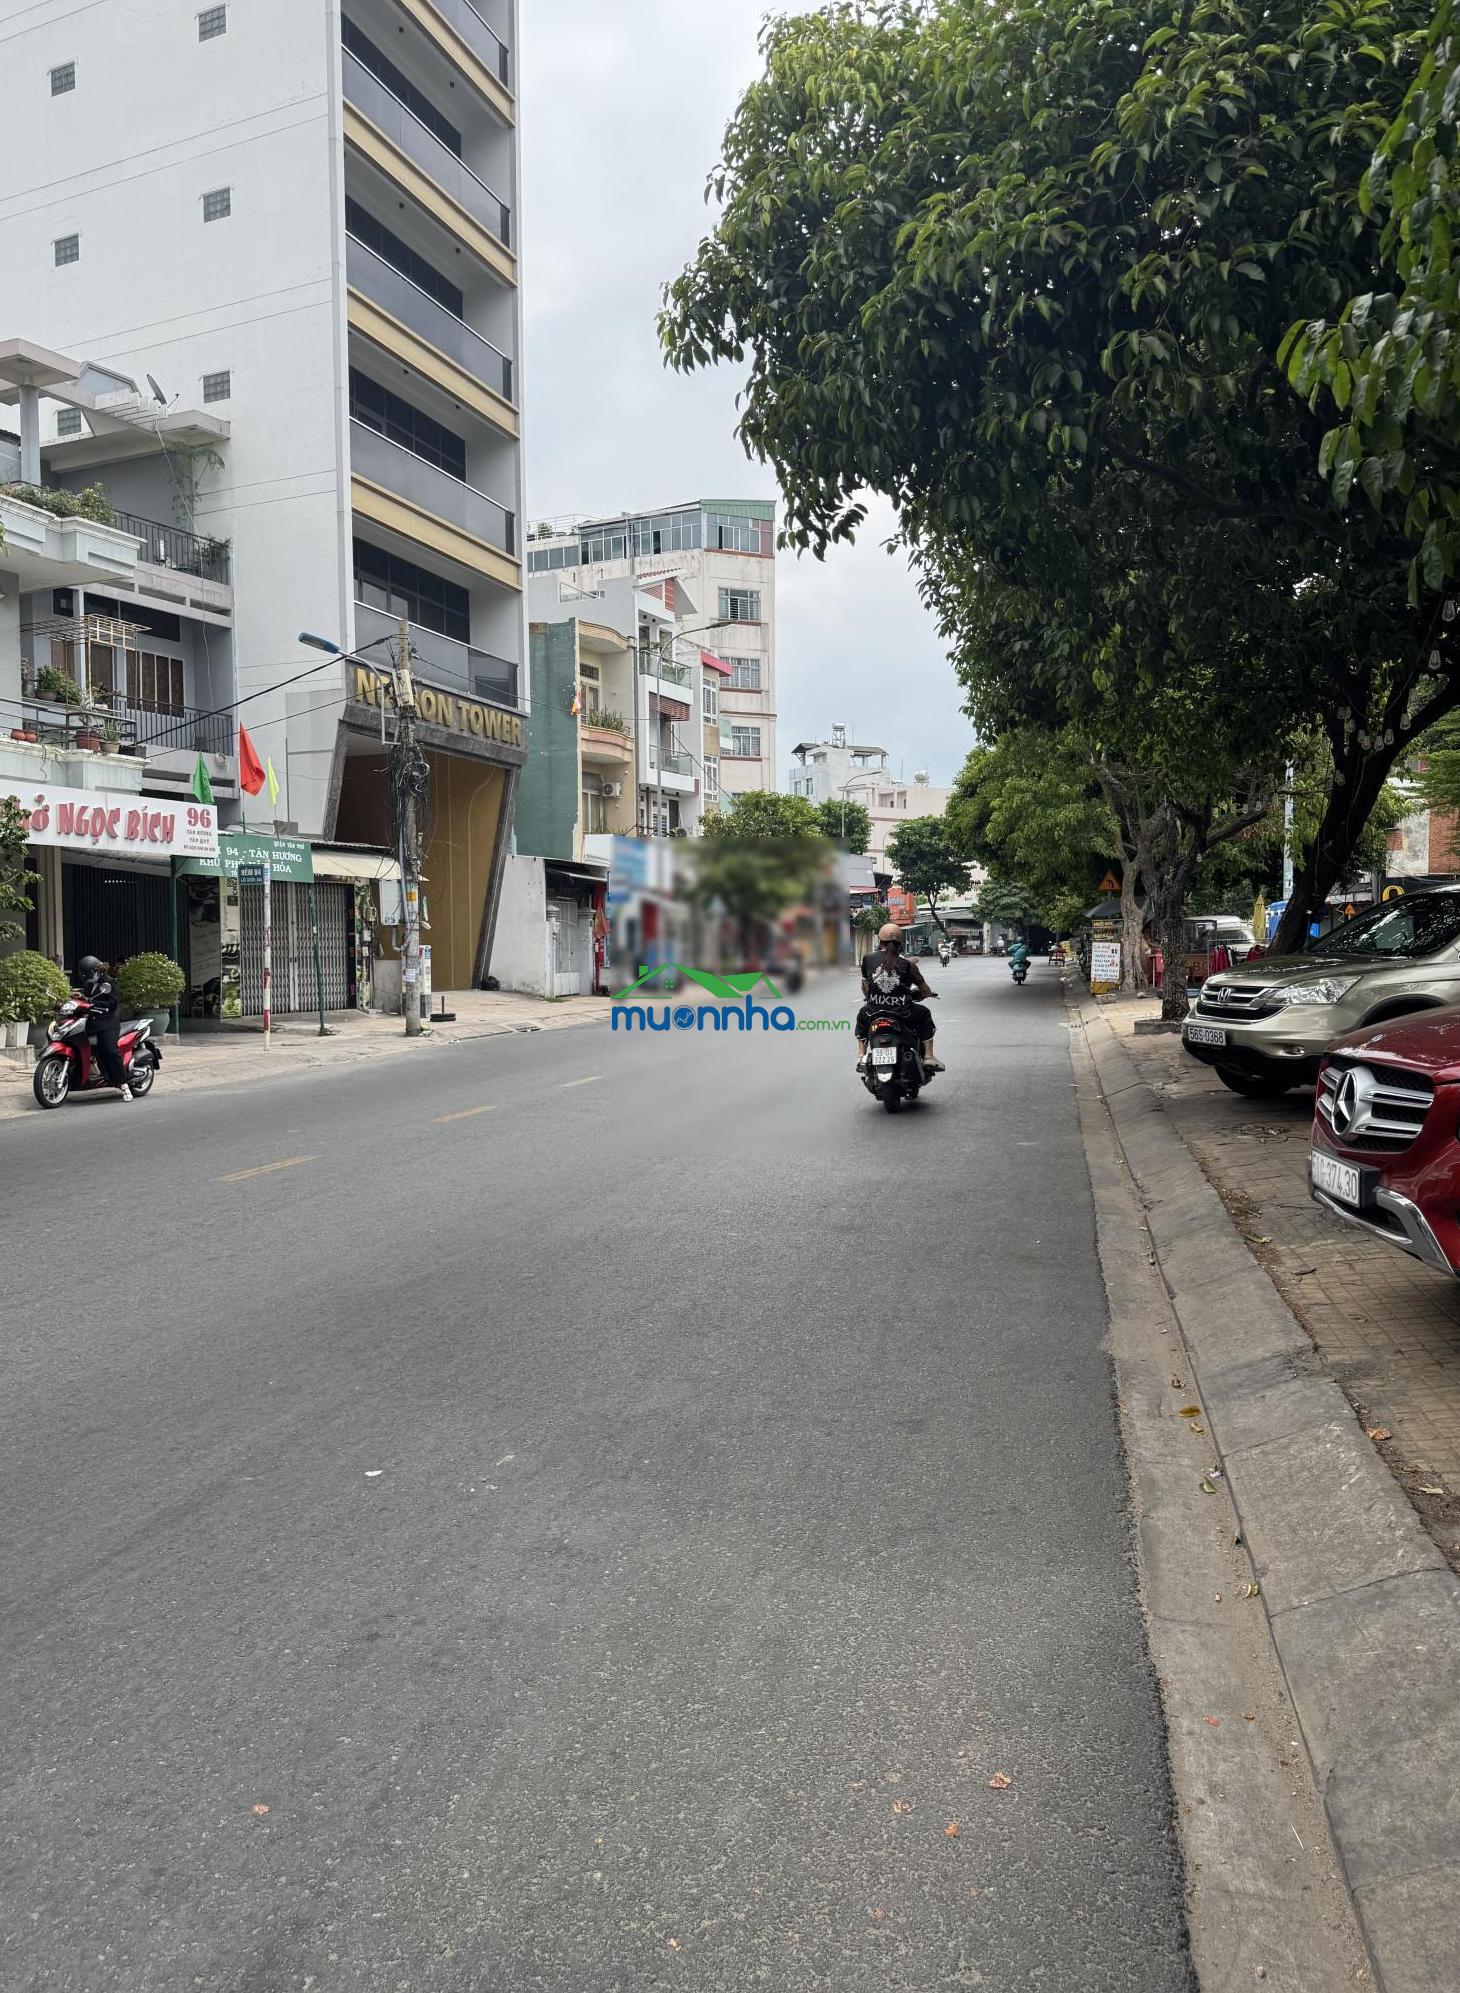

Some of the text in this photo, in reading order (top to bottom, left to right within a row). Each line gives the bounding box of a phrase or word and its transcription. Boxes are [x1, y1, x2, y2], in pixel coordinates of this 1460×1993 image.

[458, 702, 521, 746] TOWER
[57, 803, 121, 845] NGỌC
[125, 806, 176, 844] BÍCH
[187, 807, 212, 829] 96
[226, 847, 239, 857] 94
[249, 847, 269, 859] TÂN
[272, 851, 303, 863] HƯƠNG
[272, 861, 293, 874] HÓA
[1189, 1028, 1225, 1044] 56S-0368
